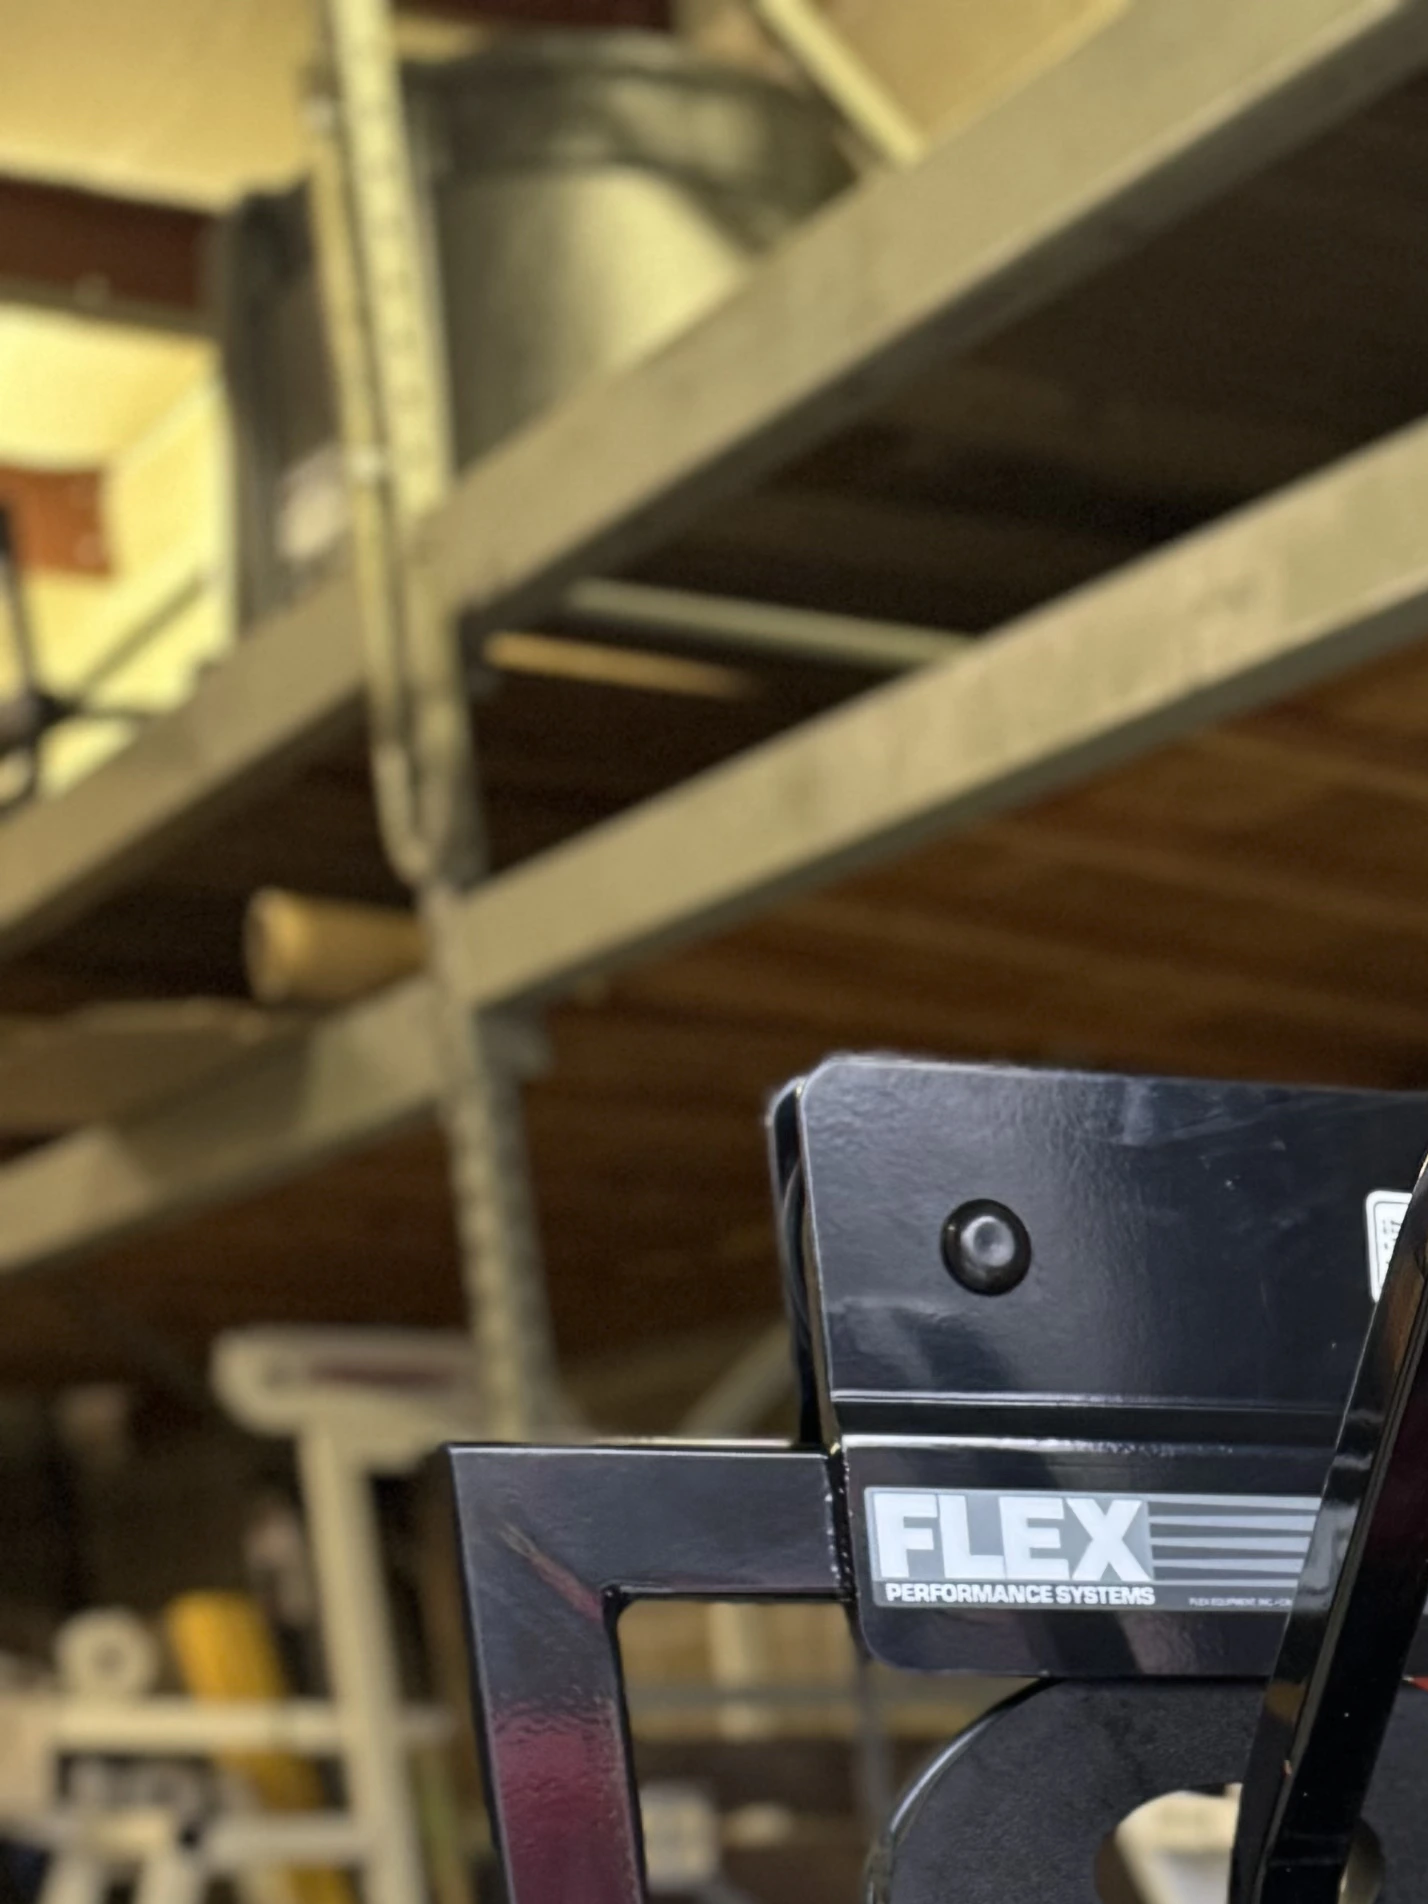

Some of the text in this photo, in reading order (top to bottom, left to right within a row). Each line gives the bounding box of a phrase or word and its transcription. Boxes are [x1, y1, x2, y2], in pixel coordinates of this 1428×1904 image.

[872, 1493, 1154, 1582] FLEX
[885, 1582, 1156, 1606] PERFORMANCE SYSTEMS
